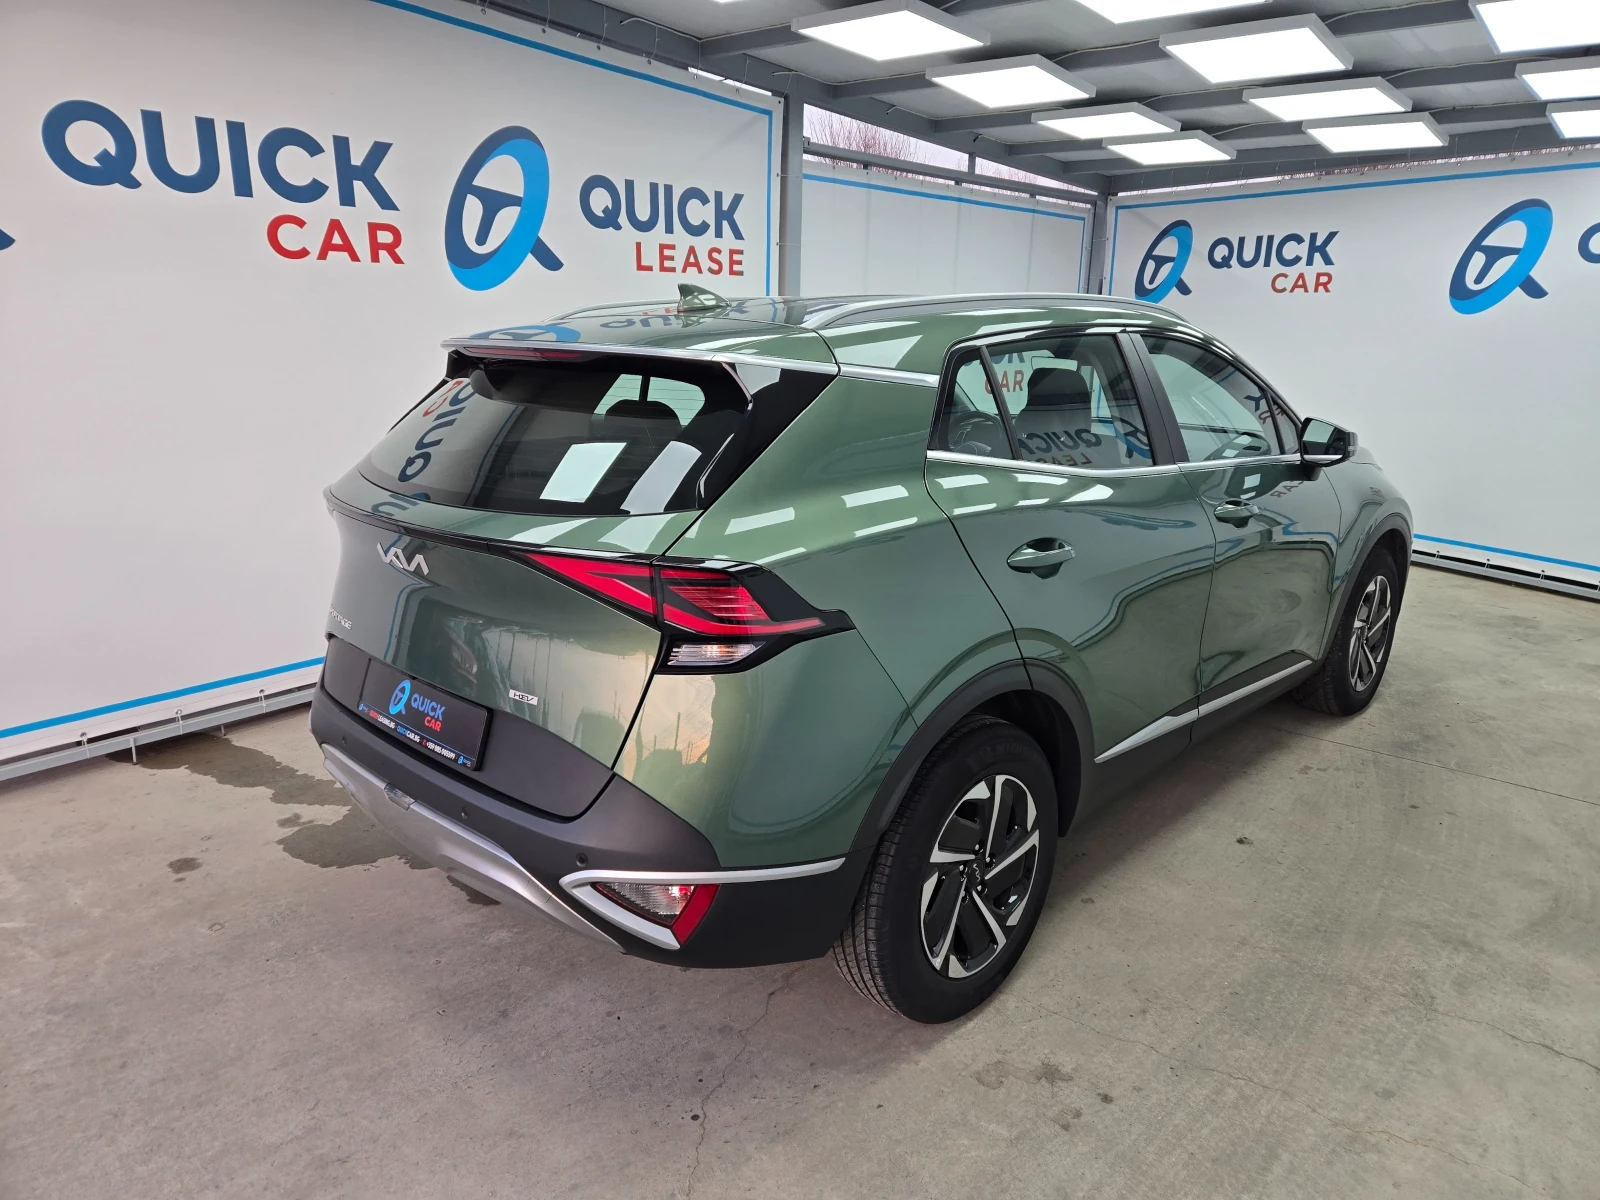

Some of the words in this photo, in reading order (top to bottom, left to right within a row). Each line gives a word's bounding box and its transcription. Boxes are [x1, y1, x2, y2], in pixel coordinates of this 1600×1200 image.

[41, 99, 399, 211] QUICK
[579, 174, 745, 241] QUICK
[266, 214, 405, 265] CAR
[1207, 230, 1339, 269] QUICK
[635, 242, 745, 276] LEASE
[1270, 272, 1333, 293] CAR
[411, 693, 446, 721] QUICK
[424, 715, 442, 732] CAR
